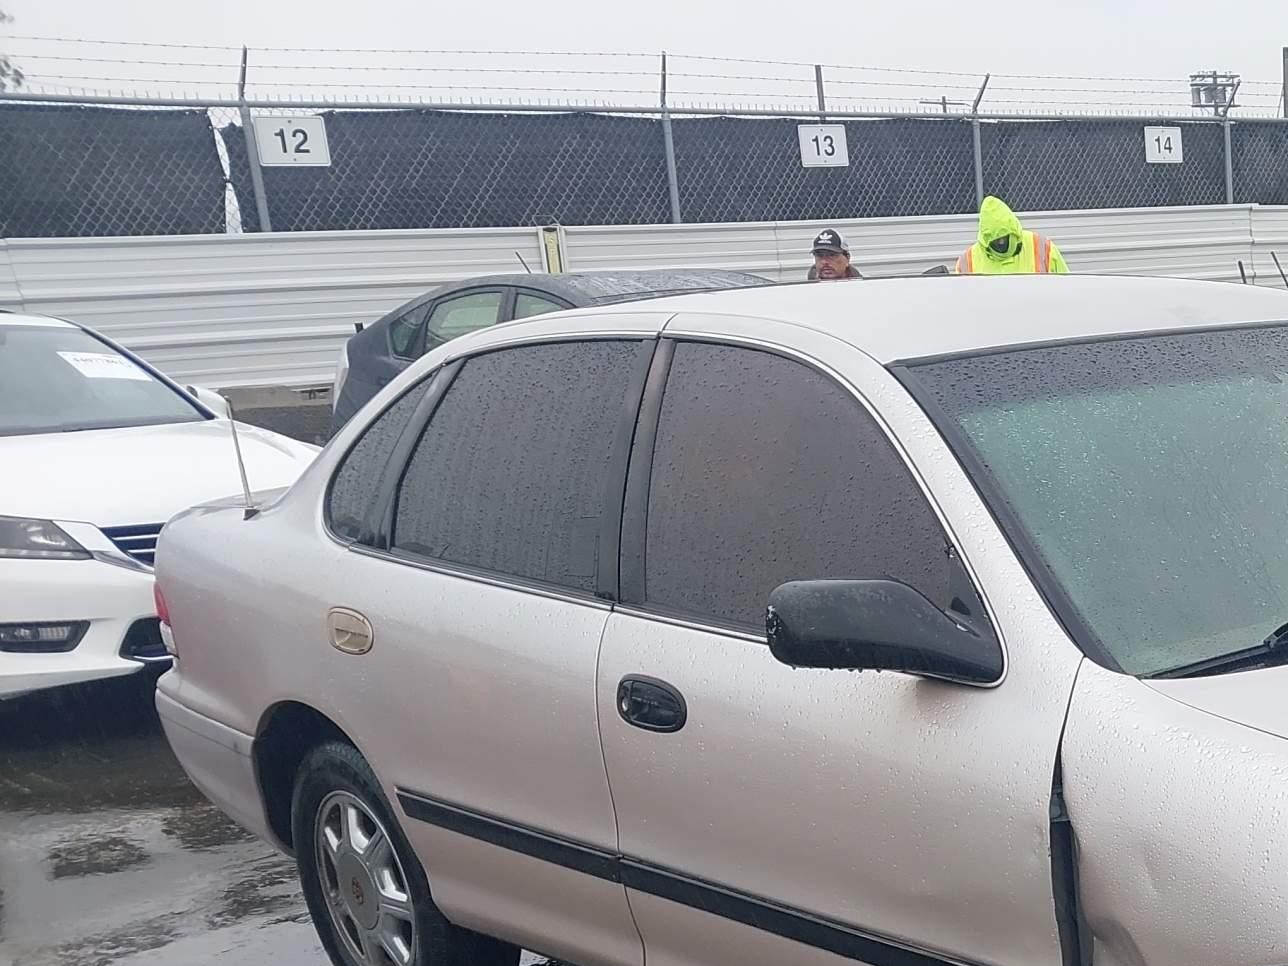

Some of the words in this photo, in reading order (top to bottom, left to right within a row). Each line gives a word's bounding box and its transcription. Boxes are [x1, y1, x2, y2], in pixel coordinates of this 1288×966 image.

[274, 127, 311, 154] 12
[811, 134, 837, 157] 13
[1154, 135, 1174, 155] 14
